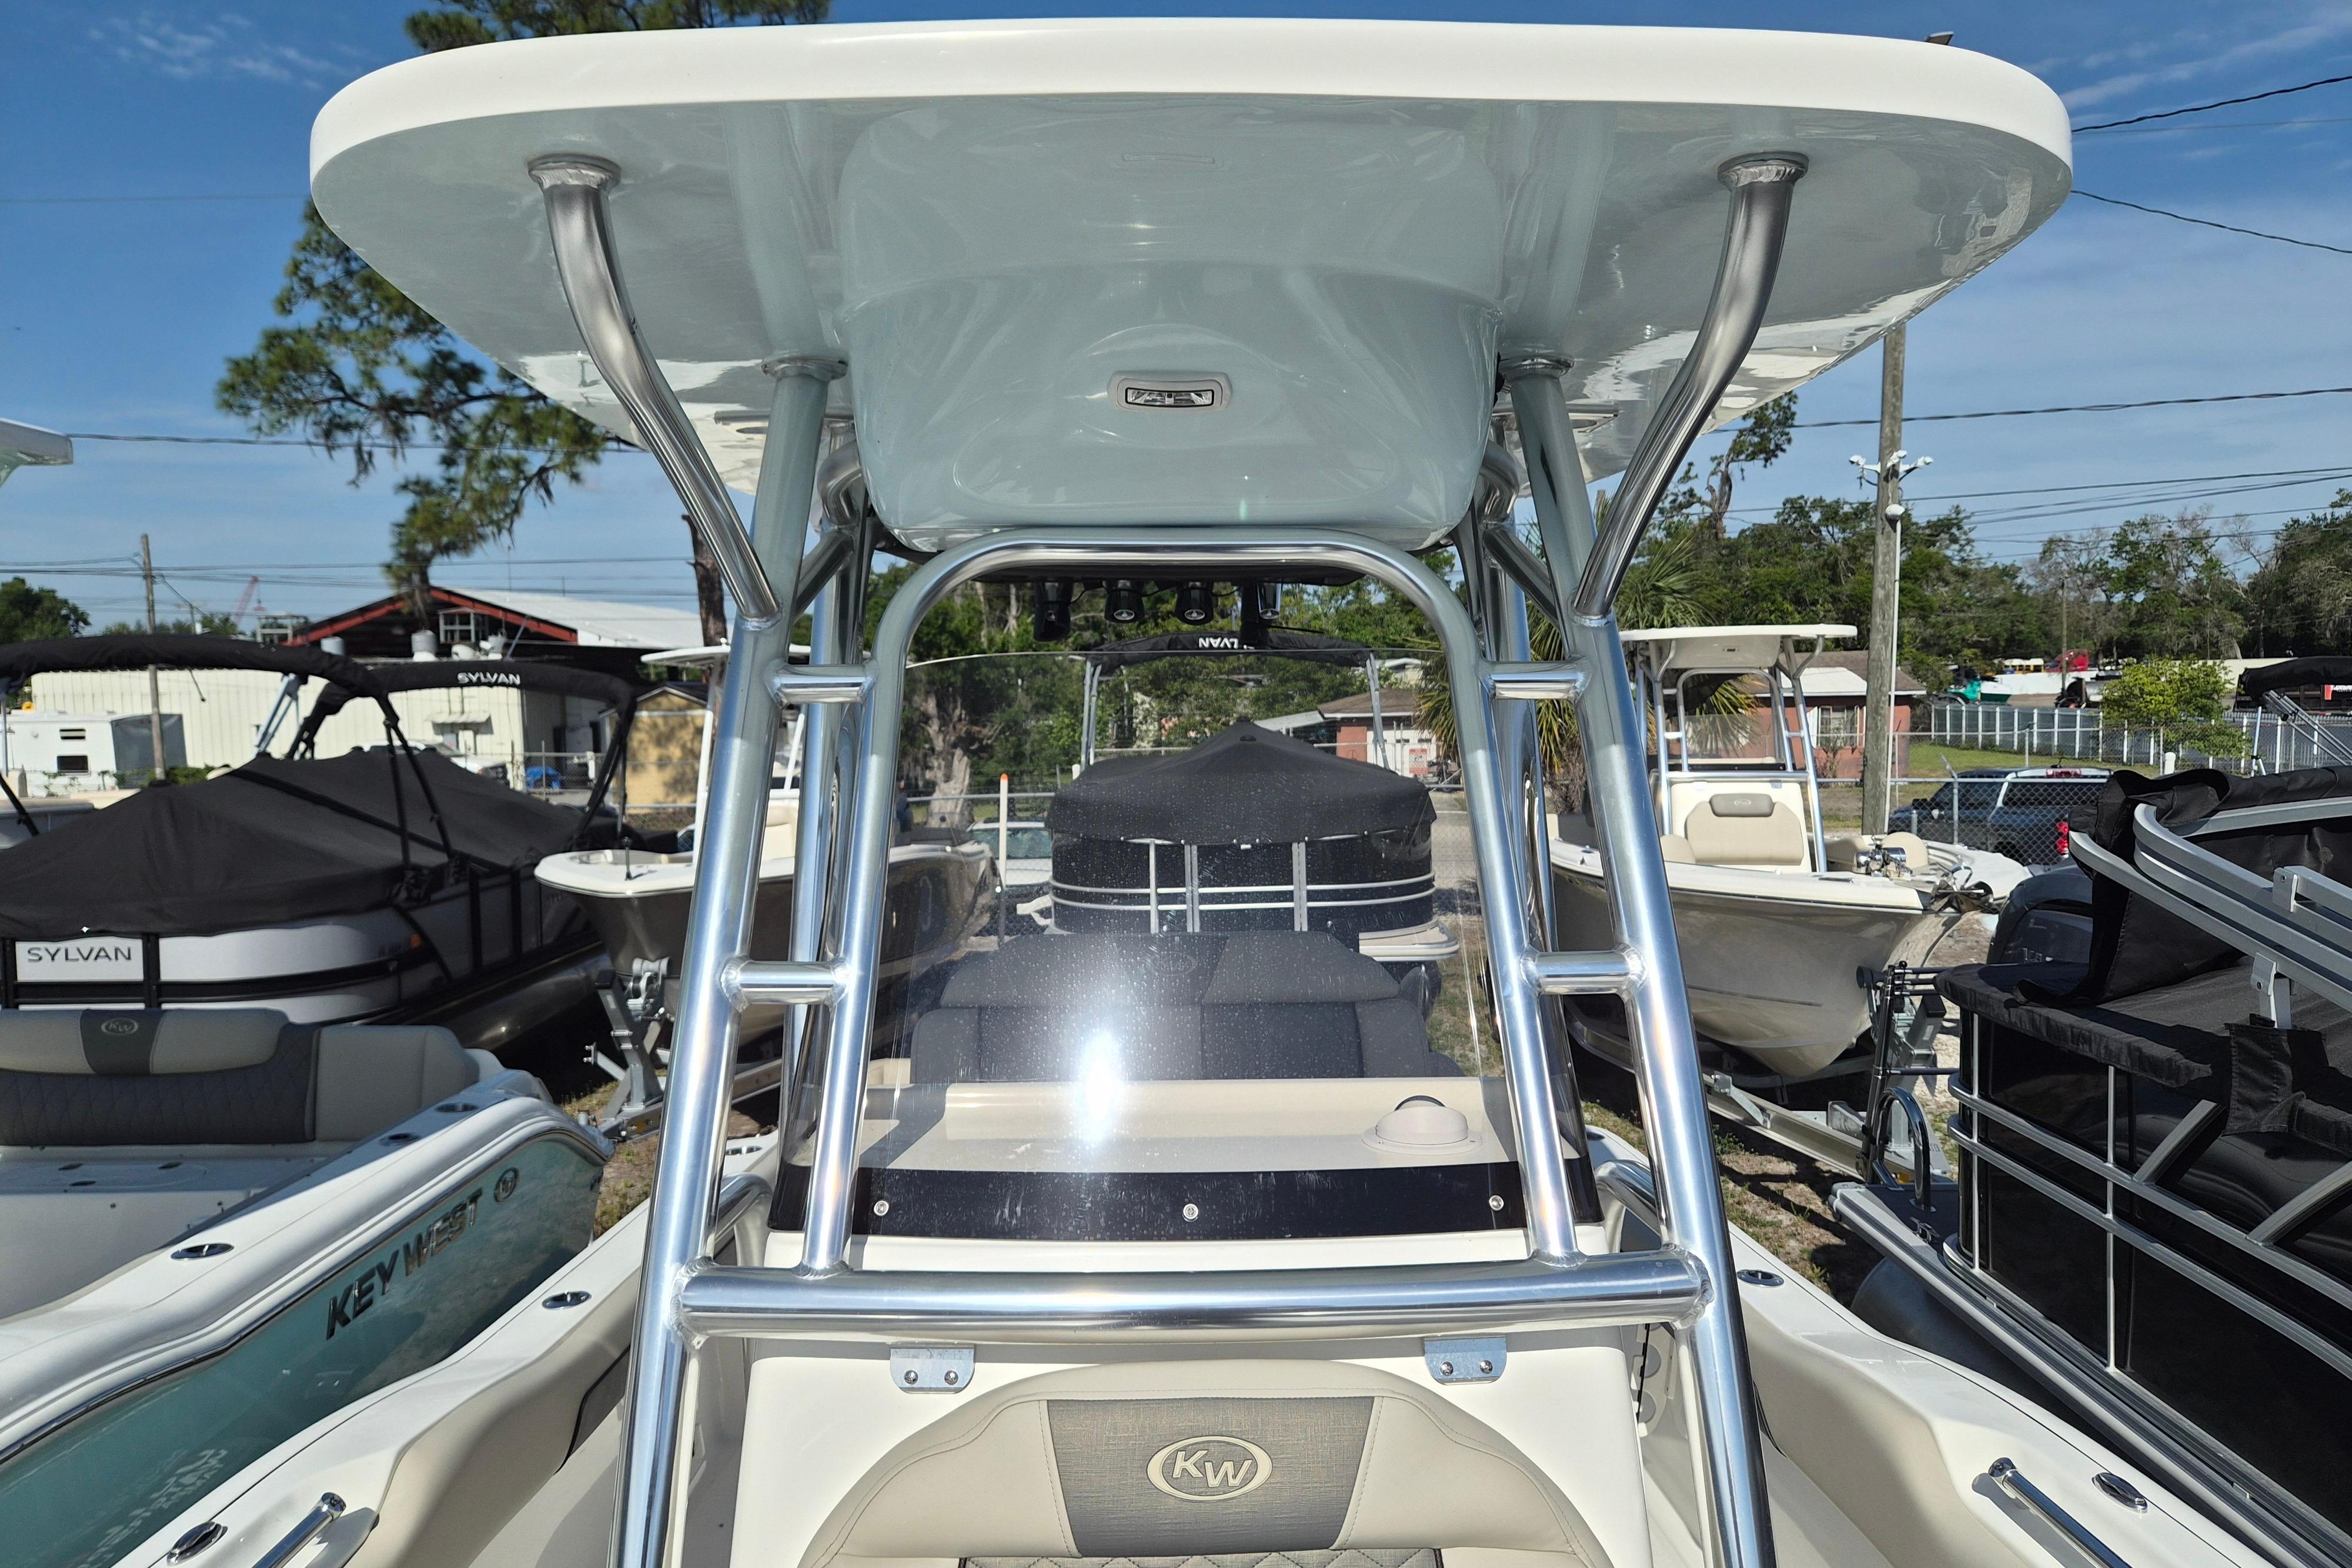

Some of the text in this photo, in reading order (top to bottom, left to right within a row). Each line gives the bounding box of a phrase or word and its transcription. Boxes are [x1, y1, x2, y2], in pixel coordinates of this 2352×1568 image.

[1198, 637, 1254, 650] LVAN
[457, 671, 521, 685] SYLVAN
[27, 946, 131, 962] SYLVAN
[326, 1186, 483, 1340] KEY WEST
[1172, 1449, 1254, 1488] KW
